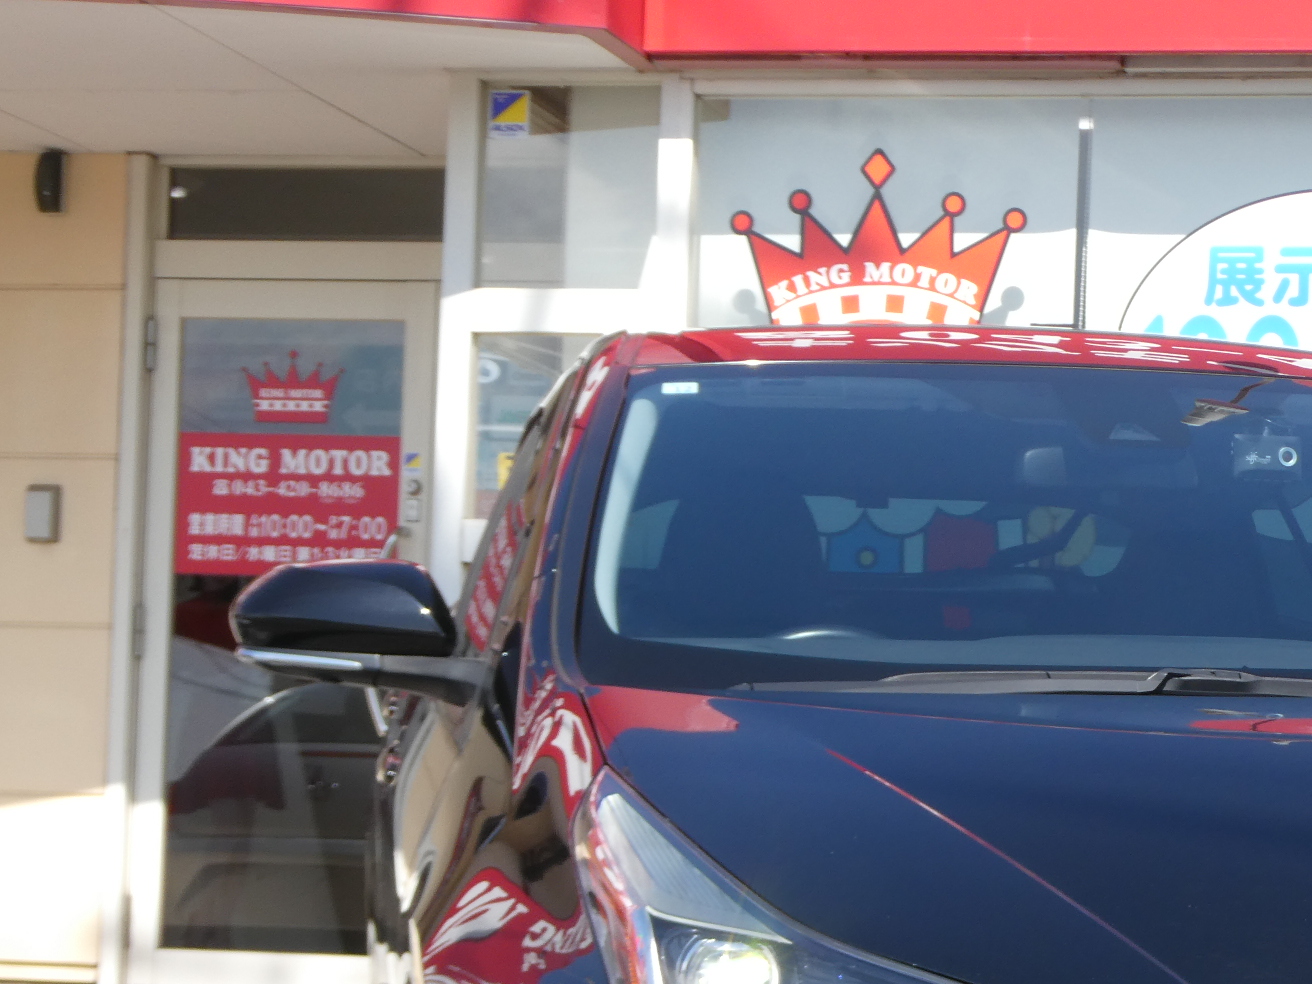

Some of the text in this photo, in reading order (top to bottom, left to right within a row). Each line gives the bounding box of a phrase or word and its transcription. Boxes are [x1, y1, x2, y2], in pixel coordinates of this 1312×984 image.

[767, 262, 979, 304] KING MOTOR
[189, 446, 393, 476] KING MOTOR
